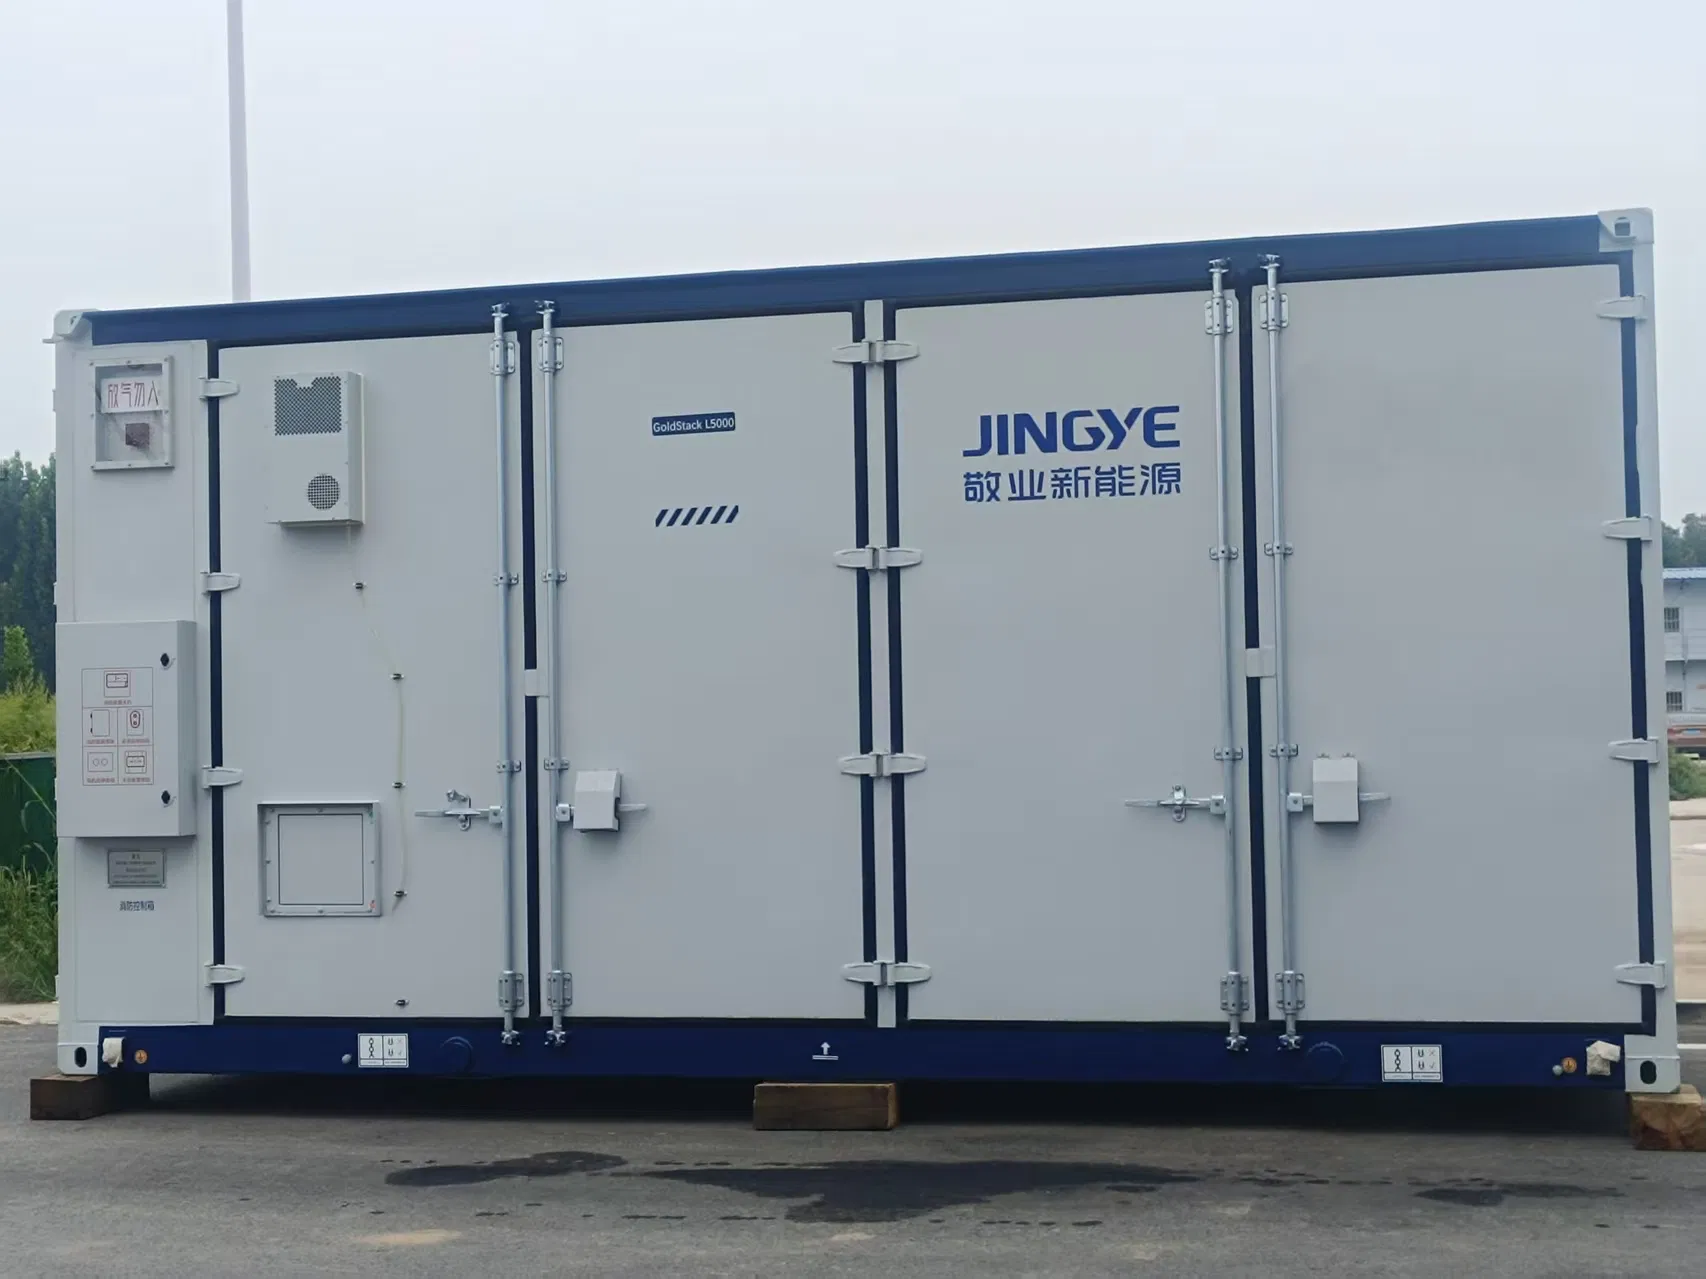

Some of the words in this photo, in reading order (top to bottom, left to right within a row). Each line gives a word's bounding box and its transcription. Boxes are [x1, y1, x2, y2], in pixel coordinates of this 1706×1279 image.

[107, 380, 159, 409] 放气勿入
[653, 420, 702, 433] GoldStack
[705, 417, 735, 429] L5000
[962, 405, 1181, 457] JINGYE
[963, 462, 1181, 503] 敬业新能源
